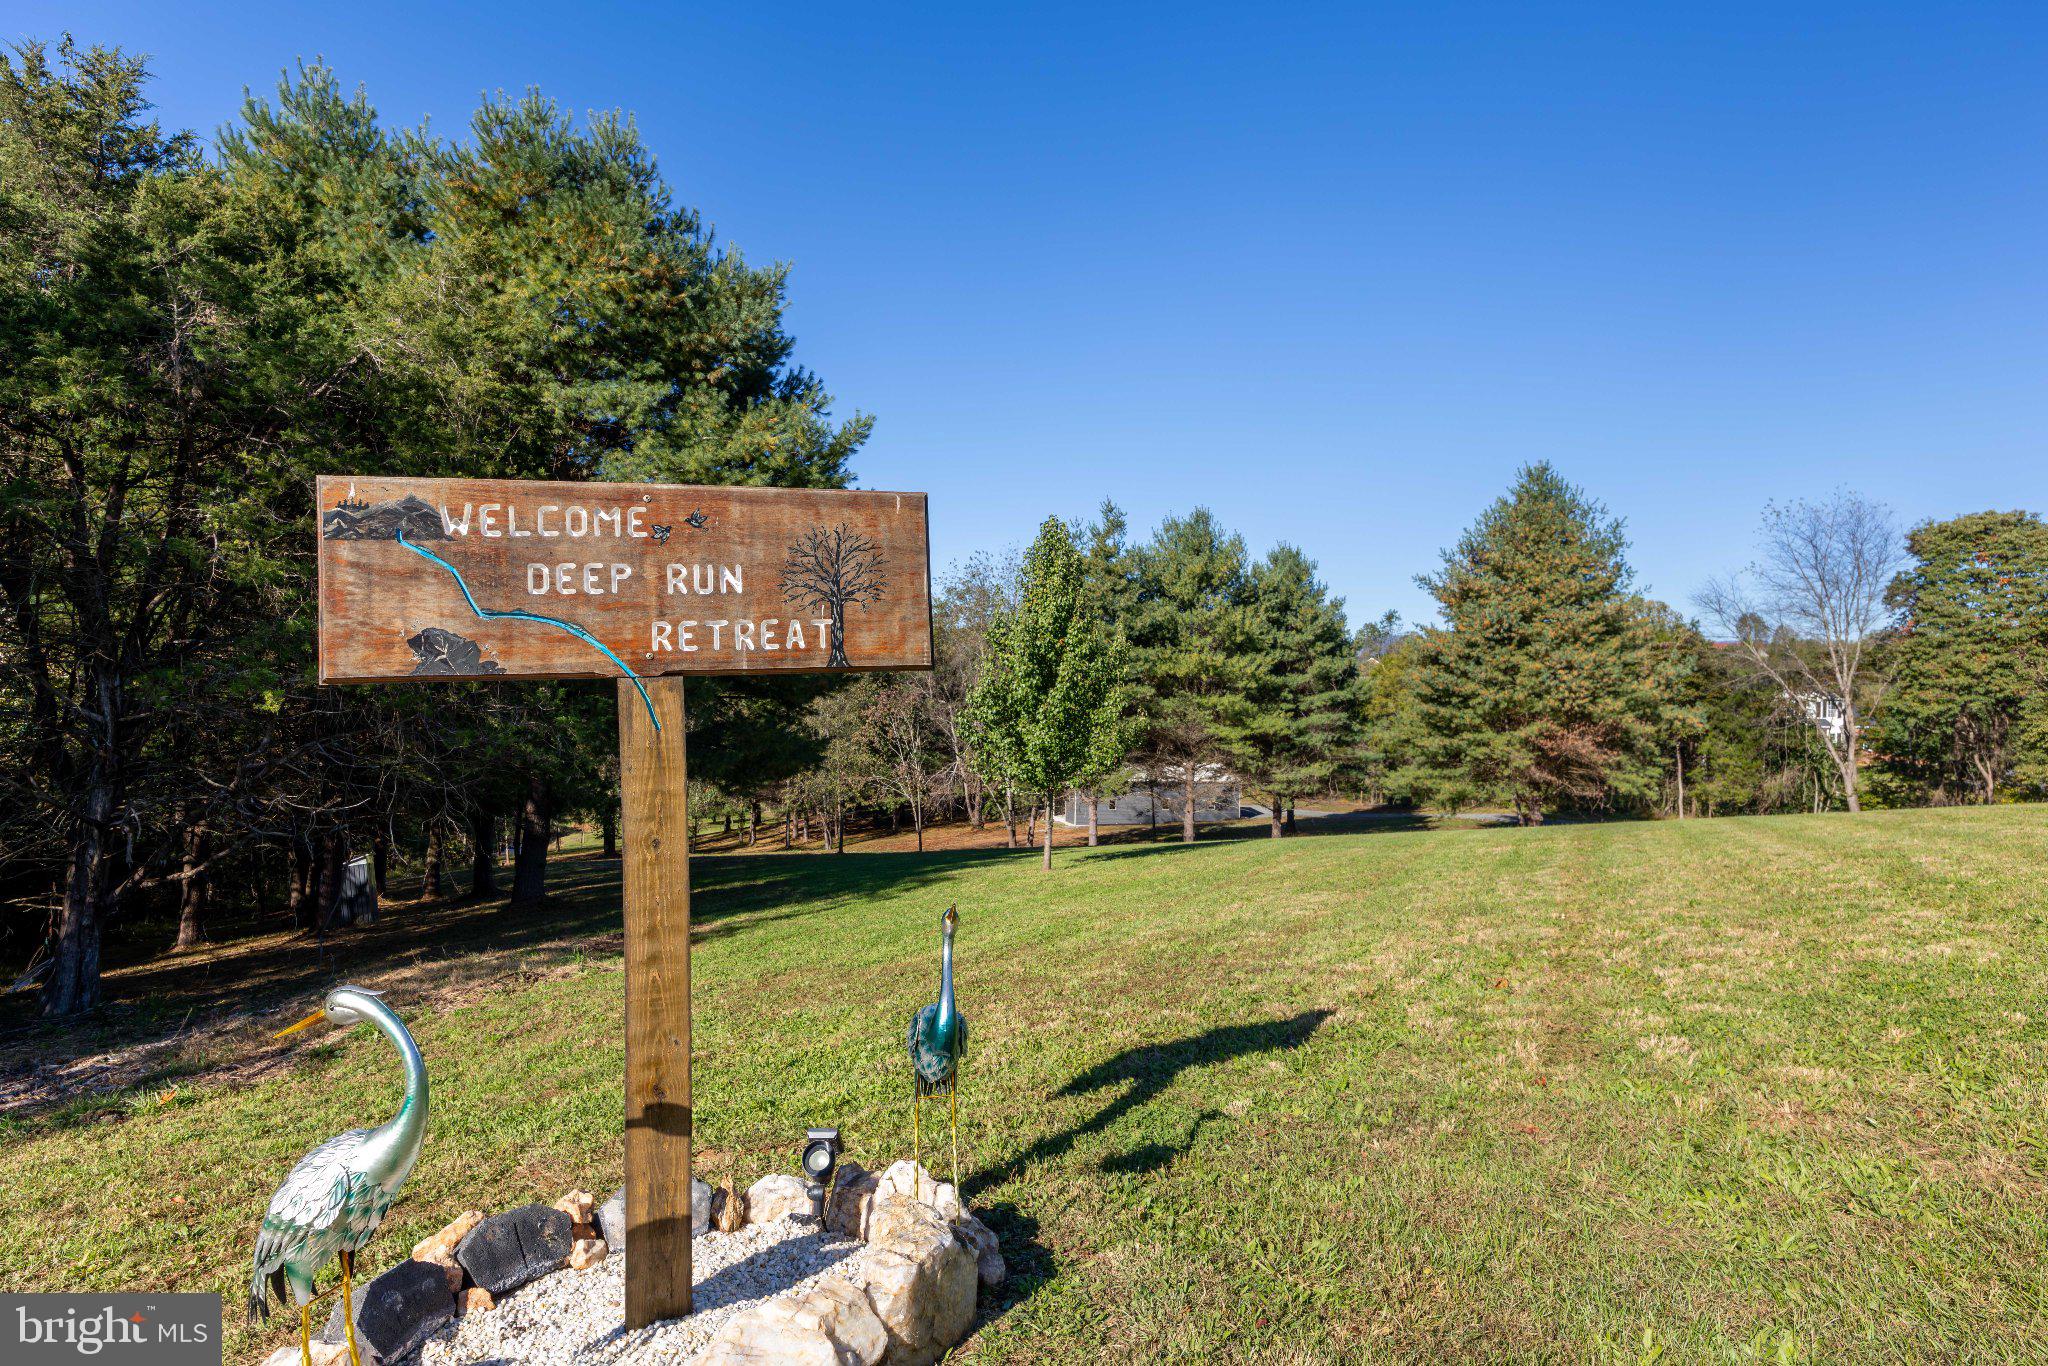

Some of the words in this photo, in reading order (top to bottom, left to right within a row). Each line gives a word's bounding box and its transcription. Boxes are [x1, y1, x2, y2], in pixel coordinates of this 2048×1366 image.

[438, 502, 648, 538] WELCOME
[528, 562, 632, 595] DEEP
[667, 563, 743, 595] RUN
[652, 618, 833, 652] RETREAT
